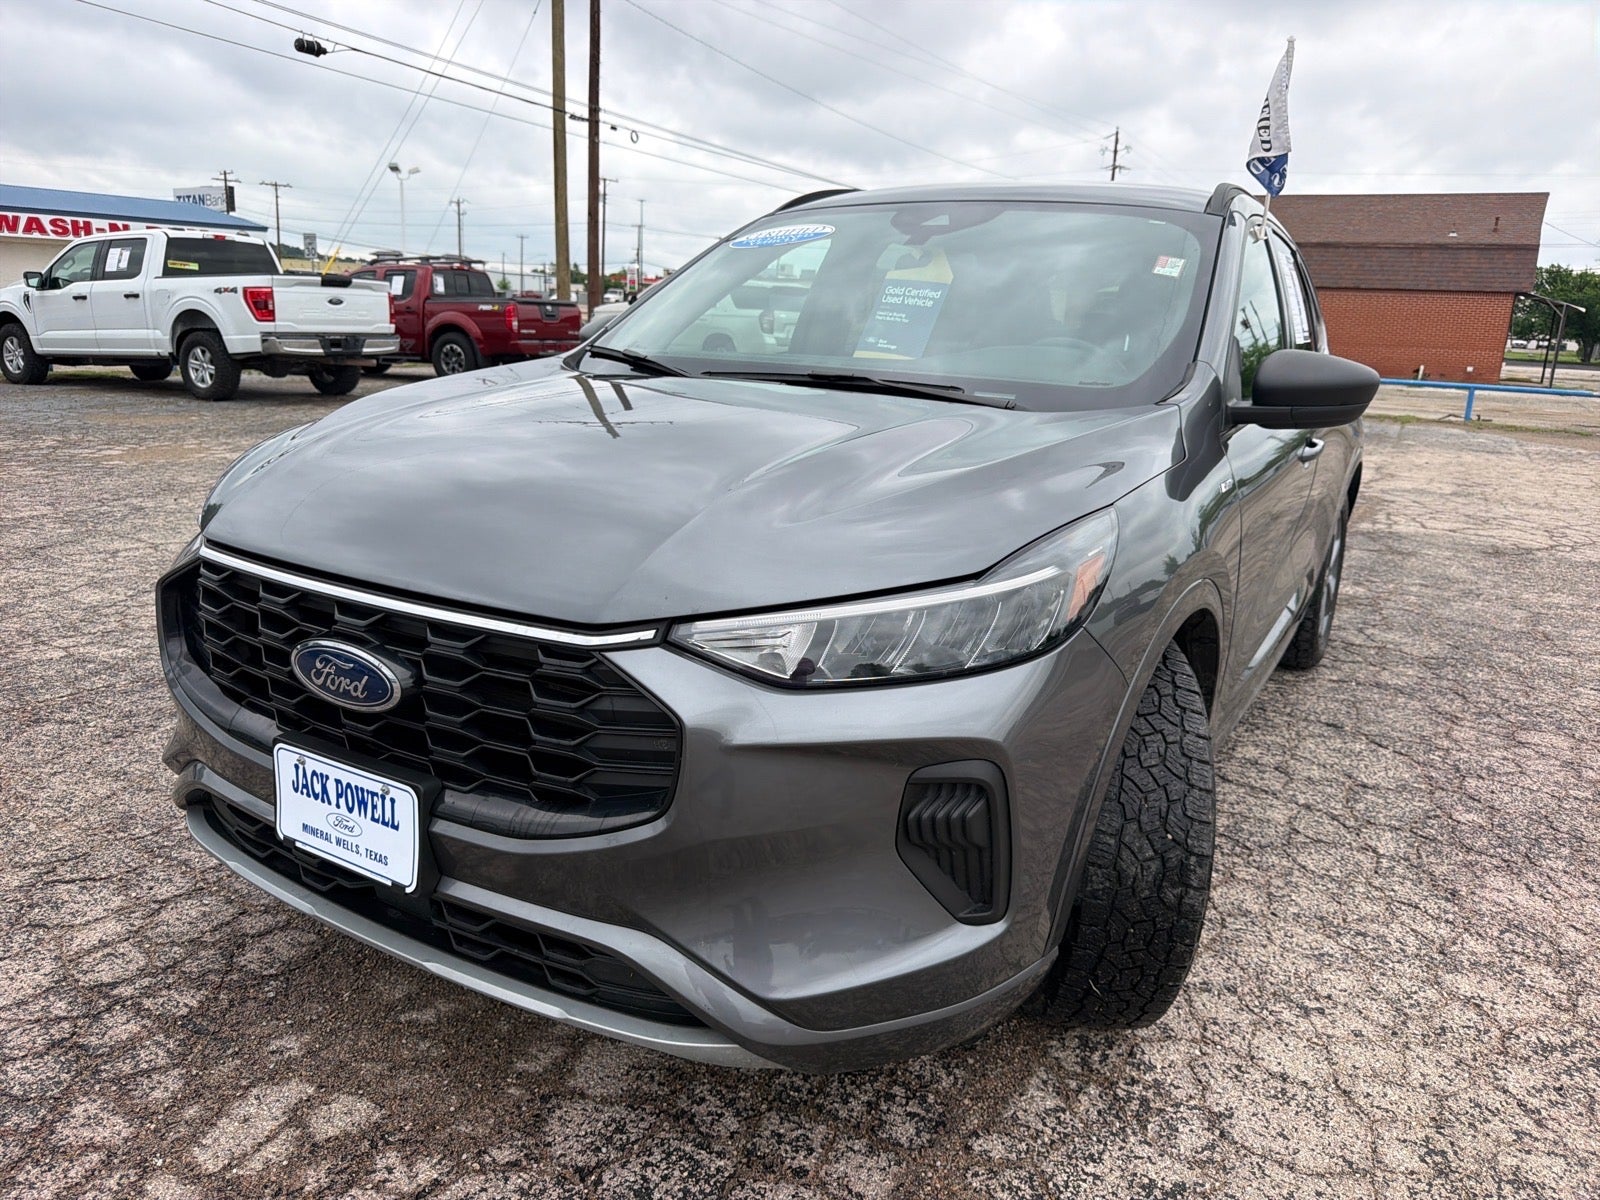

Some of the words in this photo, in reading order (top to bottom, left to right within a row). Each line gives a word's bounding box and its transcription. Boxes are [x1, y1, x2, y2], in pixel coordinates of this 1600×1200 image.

[882, 295, 903, 303] Used
[904, 296, 934, 307] Vehicle
[885, 286, 905, 295] Gold
[905, 287, 942, 298] Certified
[311, 654, 368, 698] Ford
[292, 763, 332, 806] JACK
[334, 778, 400, 832] POWELL
[333, 815, 356, 833] Ford
[302, 822, 333, 844] MINERAL
[335, 836, 363, 857] WELLS,
[365, 848, 389, 866] TEXAS
